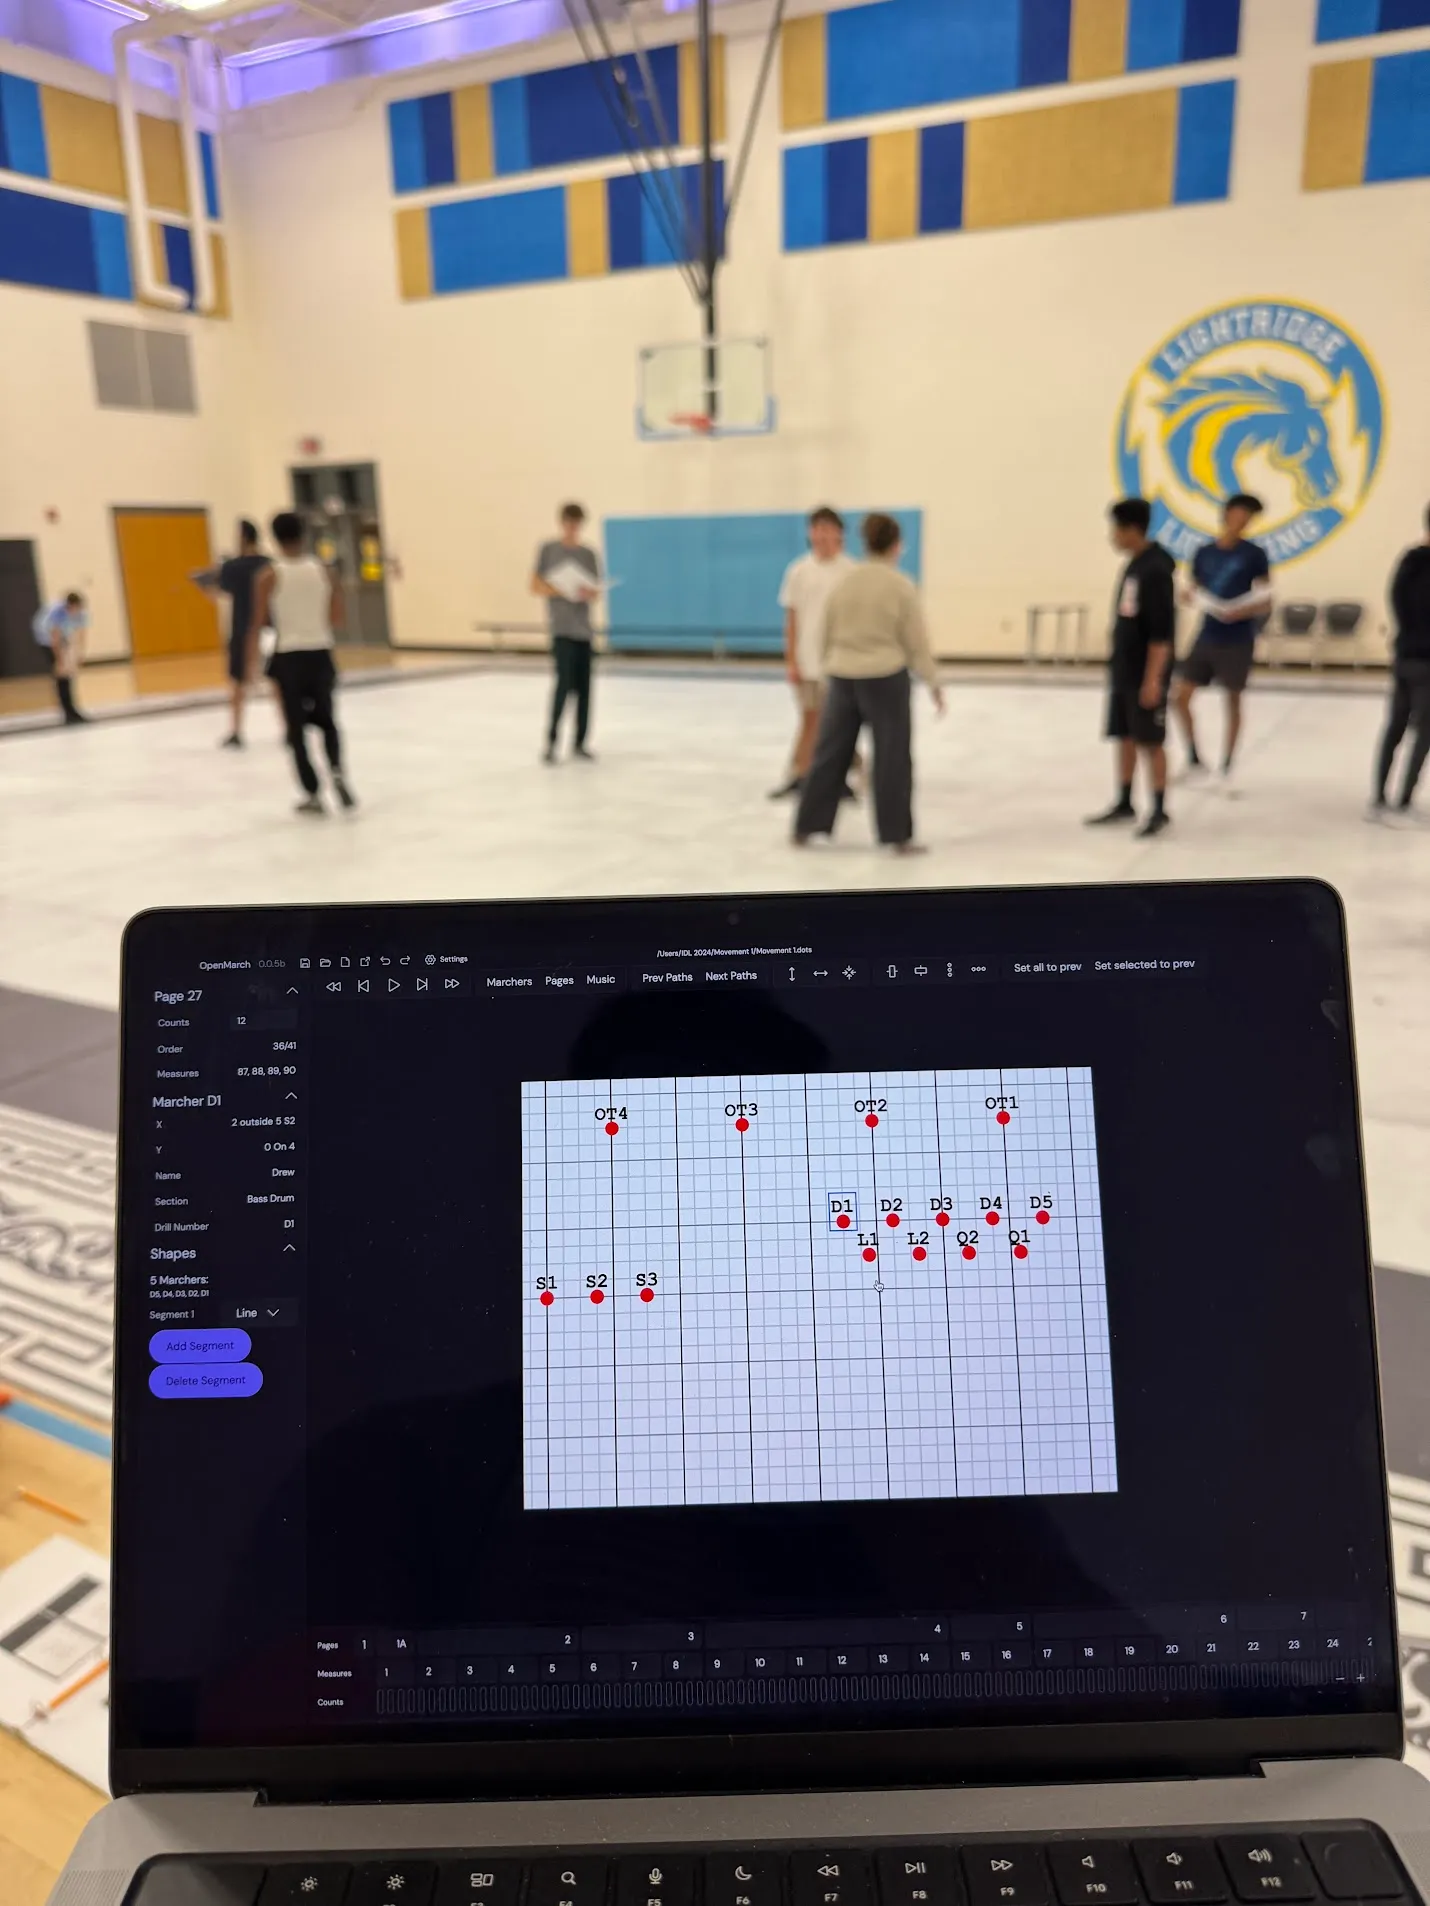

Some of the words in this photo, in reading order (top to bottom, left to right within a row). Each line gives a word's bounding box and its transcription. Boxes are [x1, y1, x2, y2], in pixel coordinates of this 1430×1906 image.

[1160, 305, 1347, 372] LIGHTRIDGE
[440, 956, 468, 964] Settings
[1095, 960, 1111, 970] Set
[1114, 960, 1157, 970] selected
[1159, 960, 1170, 968] to
[1173, 960, 1195, 970] prev
[200, 960, 251, 972] OpenMarch
[259, 960, 285, 968] 0.0.5b
[1014, 964, 1030, 972] Set
[1033, 962, 1044, 972] all
[1046, 964, 1057, 972] to
[1060, 964, 1082, 974] prev
[587, 974, 615, 984] Music
[643, 974, 667, 982] Prev
[669, 972, 693, 982] Paths
[706, 972, 728, 980] Next
[731, 970, 757, 980] Paths
[487, 976, 532, 986] Marchers
[546, 976, 574, 988] Pages
[155, 990, 184, 1004] Page
[188, 990, 202, 1002] 27
[158, 1018, 189, 1028] Counts
[237, 1016, 246, 1024] 12
[157, 1044, 183, 1054] Order
[273, 1040, 296, 1050] 36/41
[157, 1070, 199, 1078] Measures
[238, 1068, 249, 1076] 87,
[252, 1066, 265, 1076] 88,
[268, 1066, 281, 1076] 89,
[283, 1066, 296, 1074] 90
[153, 1096, 204, 1108] Marcher
[208, 1094, 221, 1106] D1
[854, 1098, 888, 1113] OT2
[985, 1096, 1019, 1110] OT1
[594, 1106, 629, 1121] OT4
[724, 1103, 759, 1117] OT3
[157, 1120, 162, 1128] X
[231, 1118, 237, 1126] 2
[240, 1116, 273, 1126] outside
[276, 1116, 282, 1126] 5
[284, 1116, 295, 1126] S2
[156, 1146, 162, 1154] Y
[264, 1142, 271, 1152] 0
[274, 1142, 287, 1152] On
[289, 1142, 295, 1150] 4
[156, 1172, 181, 1180] Name
[272, 1168, 295, 1176] Drew
[155, 1196, 188, 1206] Section
[247, 1194, 268, 1204] Bass
[270, 1194, 294, 1202] Drum
[929, 1197, 953, 1211] D3
[979, 1196, 1003, 1210] D4
[1029, 1195, 1053, 1209] D5
[830, 1200, 854, 1214] D1
[880, 1198, 903, 1212] D2
[155, 1222, 171, 1232] Drill
[174, 1222, 209, 1232] Number
[284, 1220, 294, 1228] D1
[857, 1232, 879, 1246] L1
[907, 1231, 930, 1245] L2
[956, 1230, 980, 1245] Q2
[1008, 1229, 1031, 1245] Q1
[150, 1248, 196, 1262] Shapes
[150, 1276, 157, 1286] 5
[159, 1274, 208, 1286] Marchers:
[535, 1276, 558, 1290] S1
[586, 1274, 608, 1288] S2
[635, 1272, 658, 1287] S3
[150, 1290, 161, 1298] D5,
[163, 1290, 174, 1298] D4,
[175, 1290, 187, 1298] D3,
[201, 1290, 209, 1298] D1
[150, 1310, 189, 1322] Segment
[191, 1310, 194, 1318] 1
[236, 1308, 257, 1318] Line
[167, 1342, 186, 1350] Add
[190, 1342, 234, 1352] Segment
[166, 1376, 198, 1386] Delete
[201, 1376, 245, 1388] Segment
[1221, 1614, 1227, 1624] 6
[1301, 1612, 1306, 1620] 7
[934, 1624, 941, 1634] 4
[1017, 1622, 1023, 1630] 5
[565, 1634, 571, 1644] 2
[688, 1632, 694, 1640] 3
[317, 1642, 338, 1652] Pages
[362, 1640, 366, 1650] 1
[1207, 1642, 1216, 1652] 21
[1248, 1642, 1259, 1650] 22
[1288, 1640, 1300, 1650] 23
[1327, 1638, 1339, 1648] 24
[1043, 1648, 1052, 1658] 17
[1084, 1648, 1093, 1656] 18
[1125, 1646, 1134, 1656] 19
[1166, 1644, 1178, 1654] 20
[837, 1656, 846, 1664] 12
[879, 1654, 888, 1664] 13
[920, 1652, 929, 1662] 14
[961, 1652, 970, 1660] 15
[1002, 1650, 1011, 1660] 16
[673, 1660, 679, 1670] 8
[714, 1658, 720, 1668] 9
[755, 1658, 765, 1668] 10
[796, 1656, 803, 1666] 11
[385, 1668, 388, 1676] 1
[426, 1666, 432, 1676] 2
[467, 1666, 473, 1676] 3
[508, 1664, 514, 1674] 4
[550, 1664, 555, 1674] 5
[590, 1662, 597, 1672] 6
[632, 1662, 637, 1672] 7
[317, 1670, 352, 1678] Measures
[317, 1698, 343, 1706] Counts
[1175, 1880, 1192, 1890] F11
[1261, 1876, 1281, 1888] F12
[1001, 1886, 1014, 1896] F9
[1086, 1884, 1107, 1892] F10
[825, 1892, 838, 1902] F7
[913, 1890, 926, 1900] F8
[736, 1896, 750, 1906] F6
